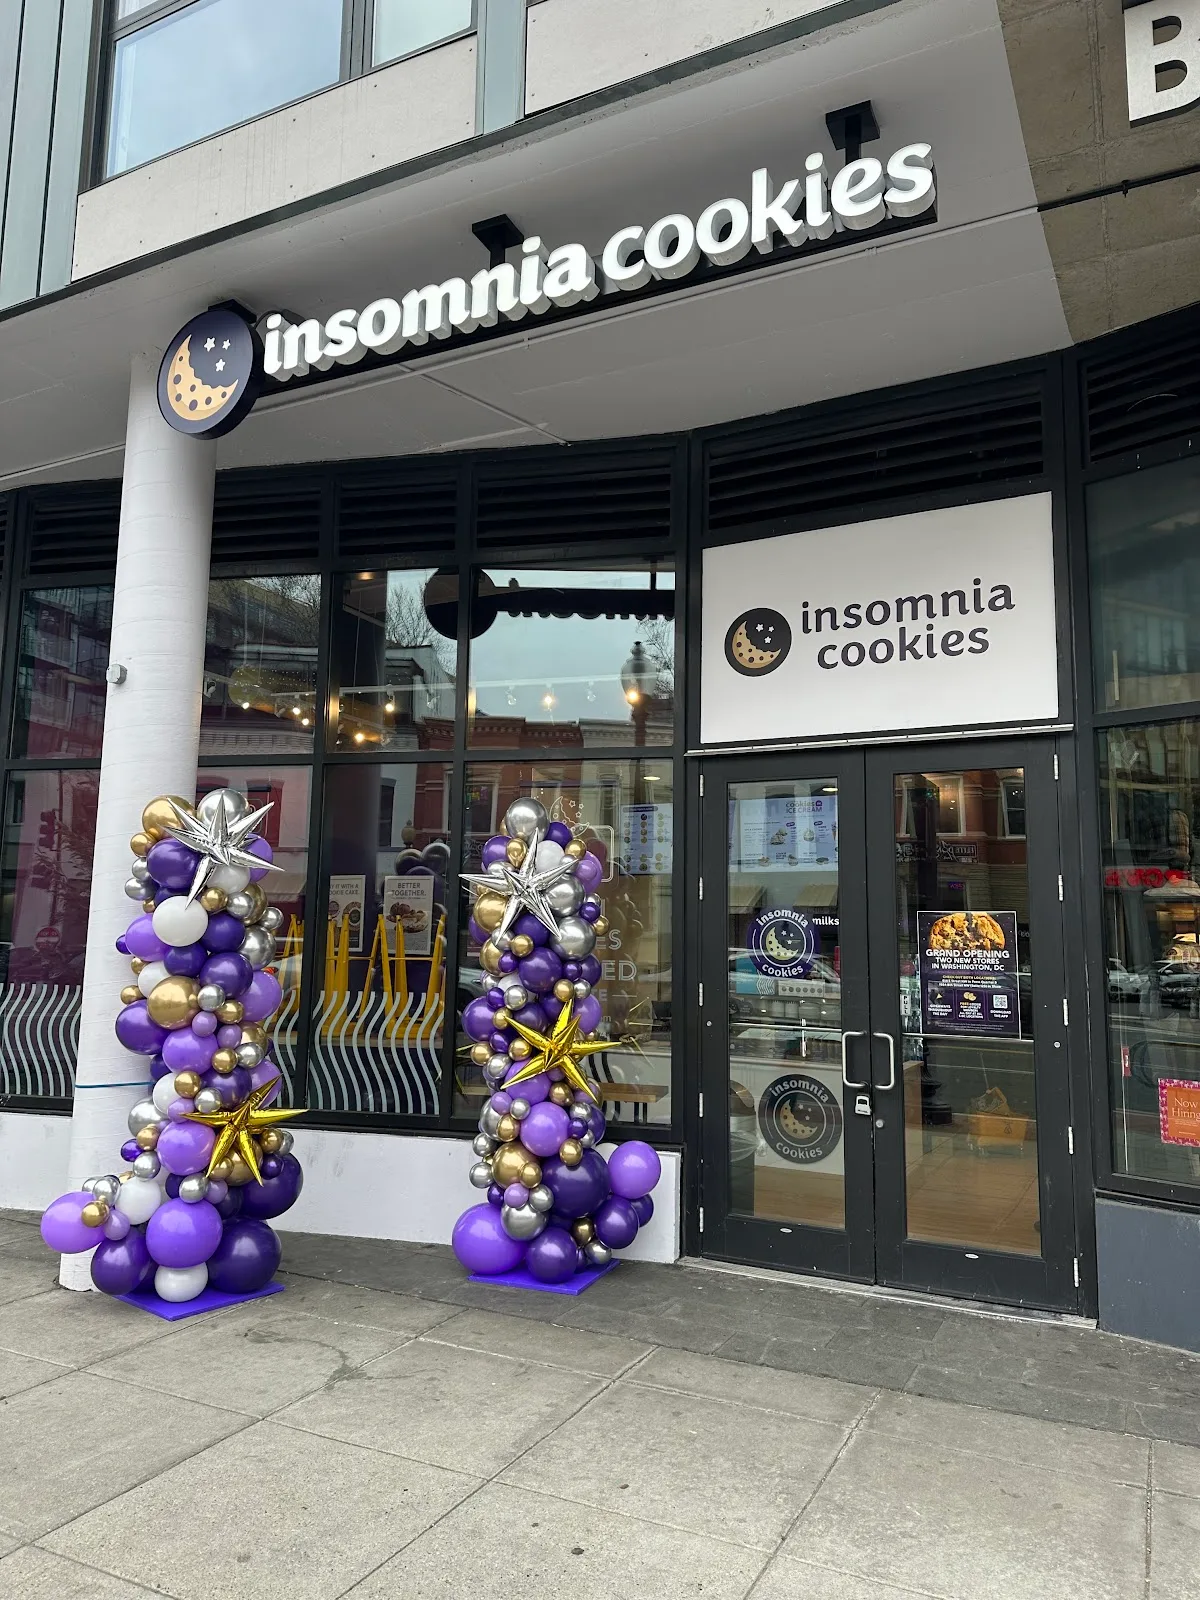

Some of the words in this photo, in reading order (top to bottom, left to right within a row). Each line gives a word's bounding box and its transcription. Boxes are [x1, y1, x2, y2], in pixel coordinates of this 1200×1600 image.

[263, 235, 595, 378] insomnia
[601, 142, 935, 285] cookies
[801, 577, 1016, 634] insomnia
[817, 623, 990, 670] cookies
[785, 800, 815, 808] cookies
[391, 889, 427, 897] TOGETHER.
[755, 909, 809, 928] insomnia
[811, 915, 840, 926] milks
[925, 948, 960, 958] GRAND
[962, 949, 1010, 959] OPENING
[761, 964, 804, 978] cookies
[941, 963, 993, 972] WASHINGTON,
[769, 1079, 829, 1103] insomnia
[1174, 1097, 1199, 1109] Now
[775, 1142, 823, 1159] cookies
